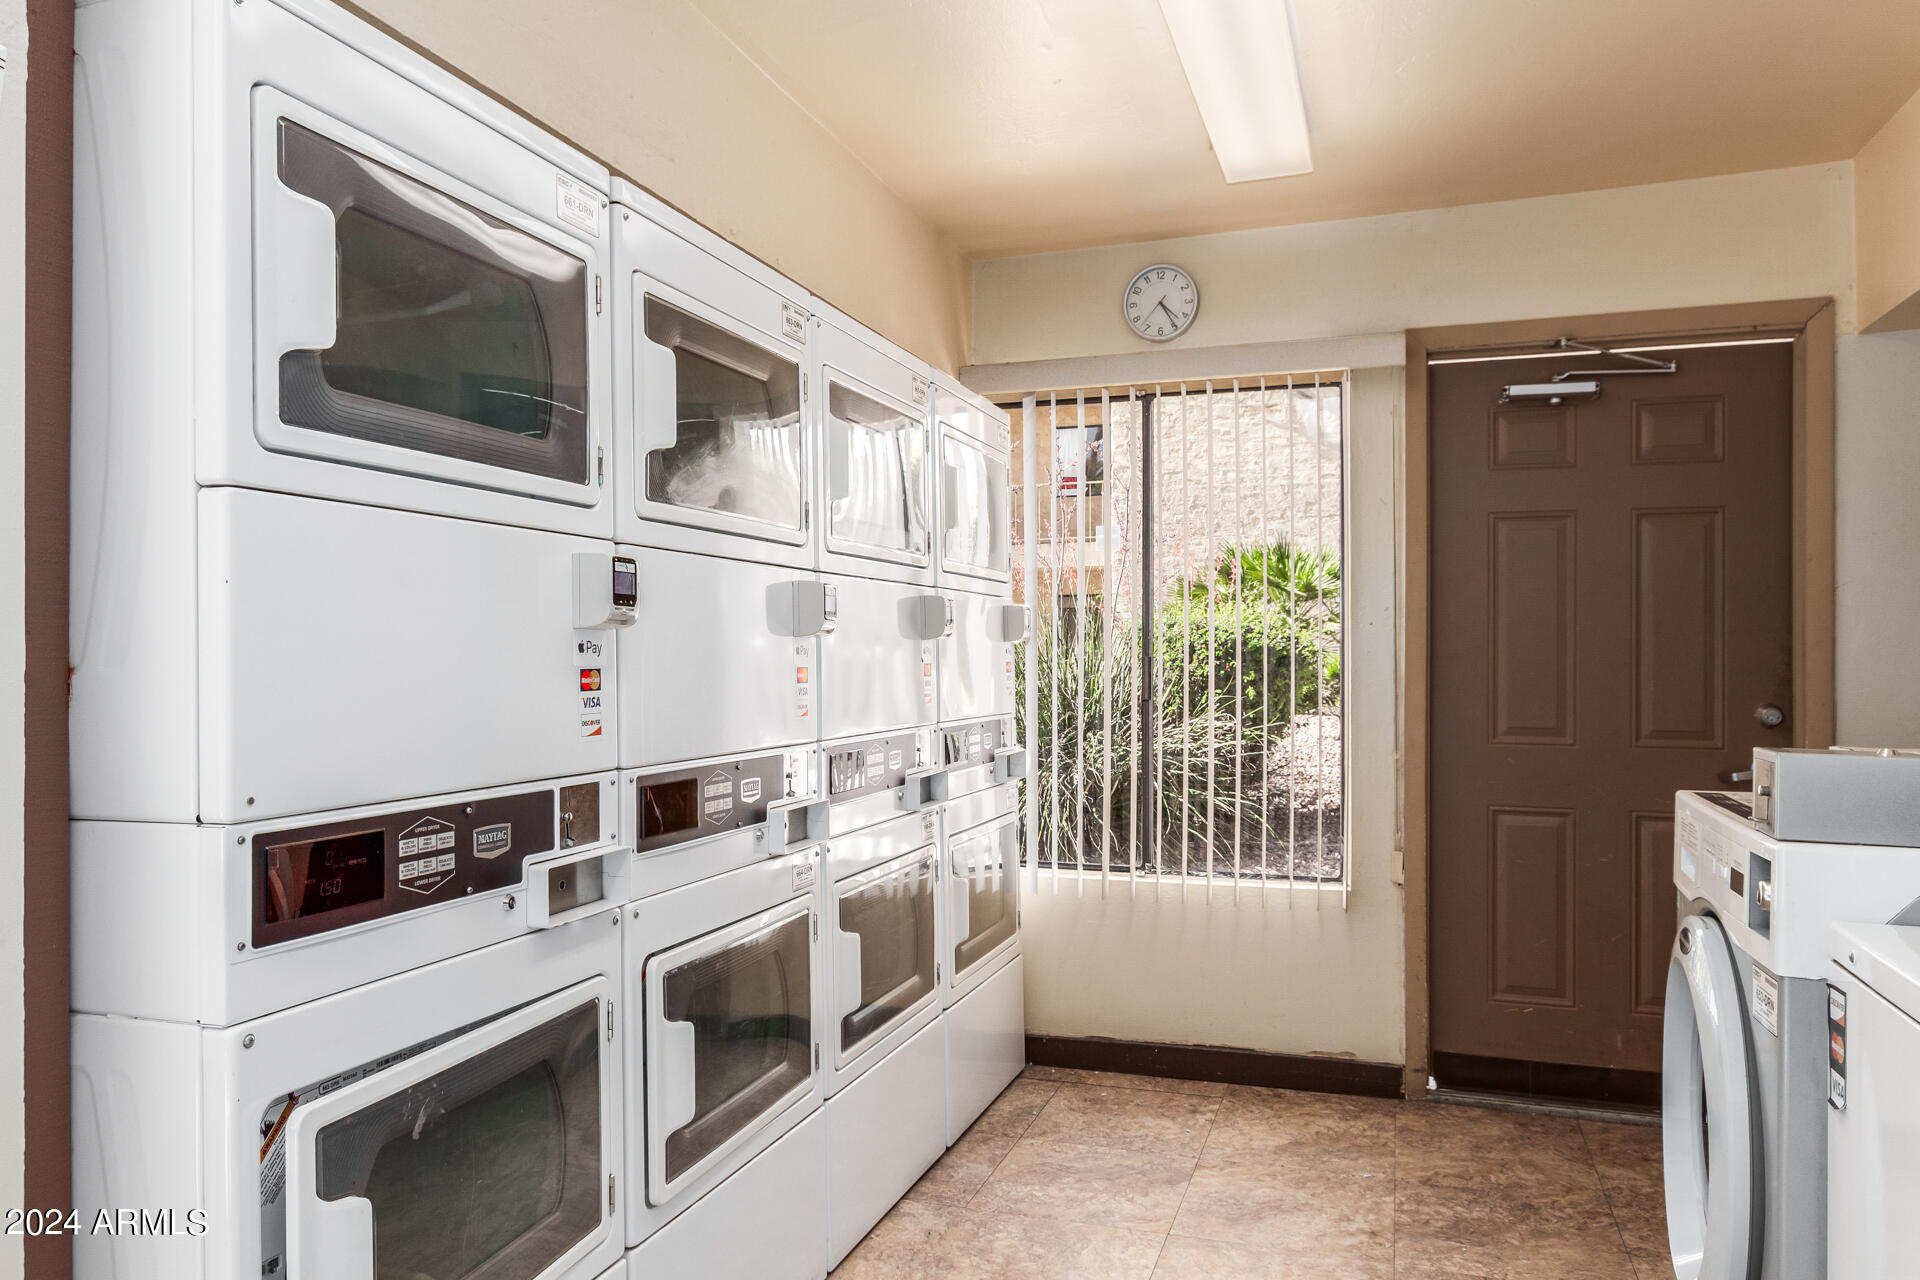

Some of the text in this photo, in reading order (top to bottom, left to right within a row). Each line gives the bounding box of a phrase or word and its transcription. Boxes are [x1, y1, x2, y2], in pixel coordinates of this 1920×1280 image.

[563, 194, 594, 219] 661-DRN
[1143, 275, 1152, 285] 11
[1156, 270, 1166, 280] 12
[1172, 273, 1178, 282] 1
[1132, 286, 1142, 296] 10
[1180, 283, 1190, 292] 2
[1184, 297, 1193, 305] 3
[1133, 315, 1141, 324] 8
[1181, 311, 1189, 319] 4
[1143, 323, 1152, 333] 7
[1157, 326, 1164, 337] 6
[586, 640, 603, 657] Pay
[583, 696, 601, 709] VISA
[478, 830, 507, 844] MAYTAG
